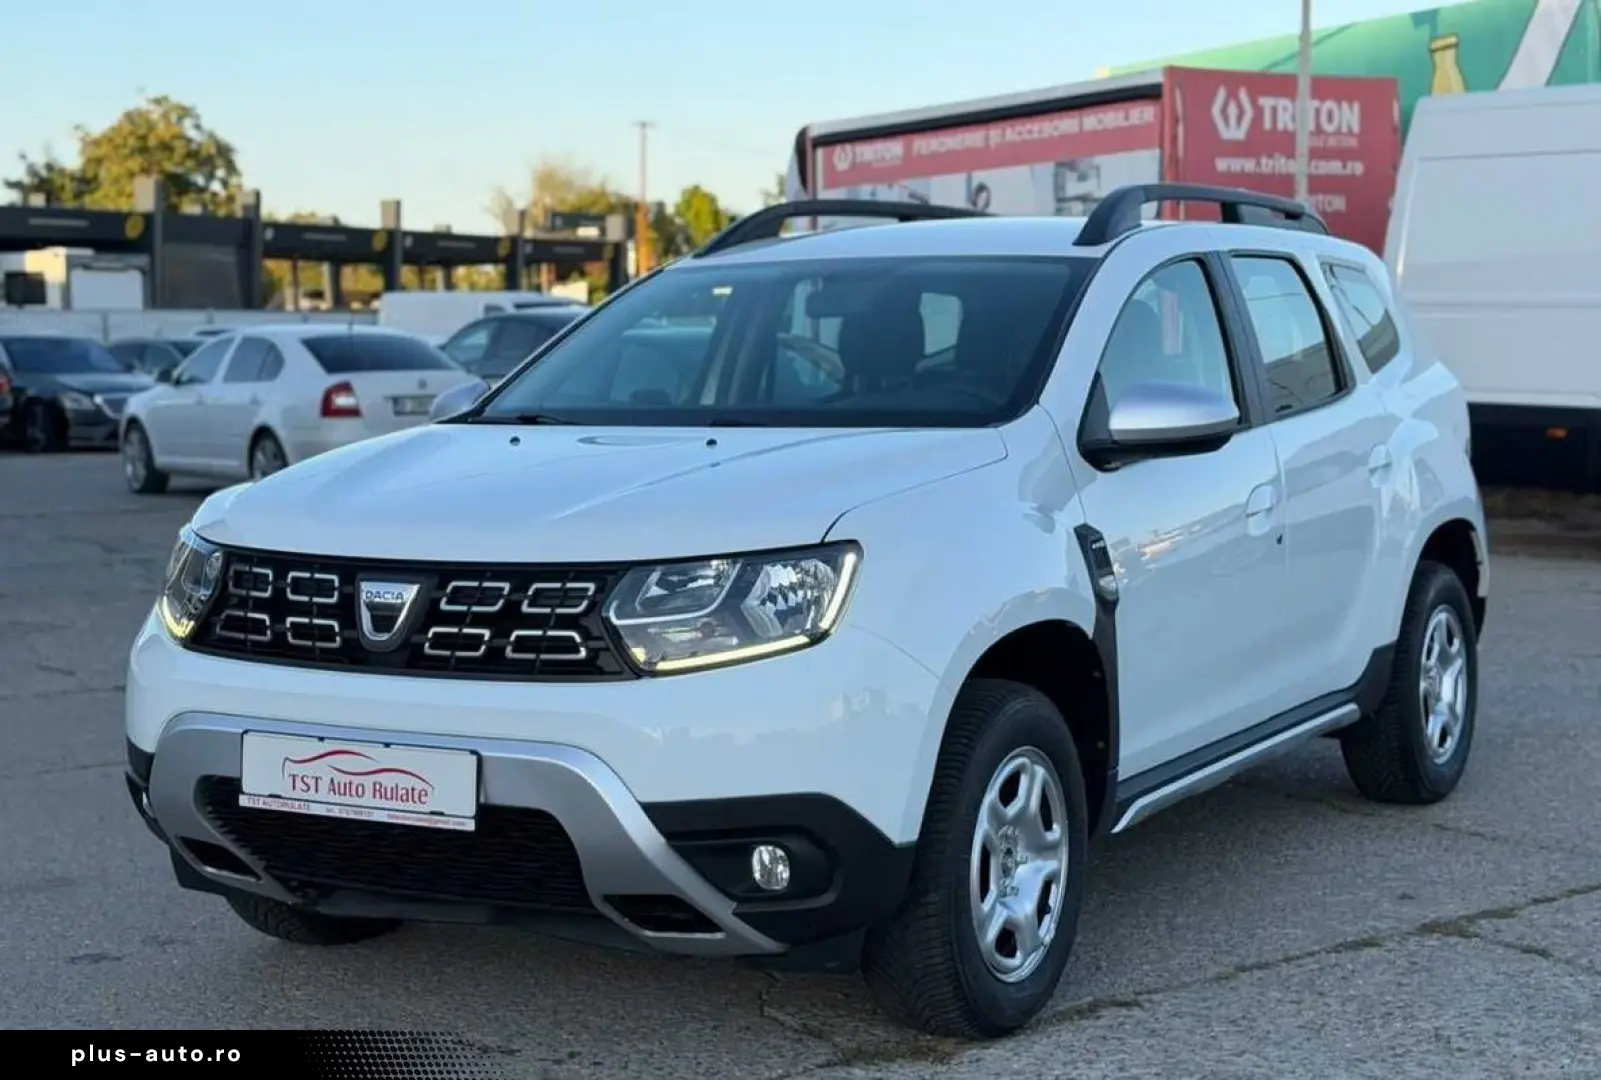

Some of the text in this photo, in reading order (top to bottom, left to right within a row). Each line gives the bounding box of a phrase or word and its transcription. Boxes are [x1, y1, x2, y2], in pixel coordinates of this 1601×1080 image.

[1082, 106, 1156, 132] MOBILIER
[365, 590, 404, 600] DACIA
[288, 773, 429, 804] TST Auto Rulate
